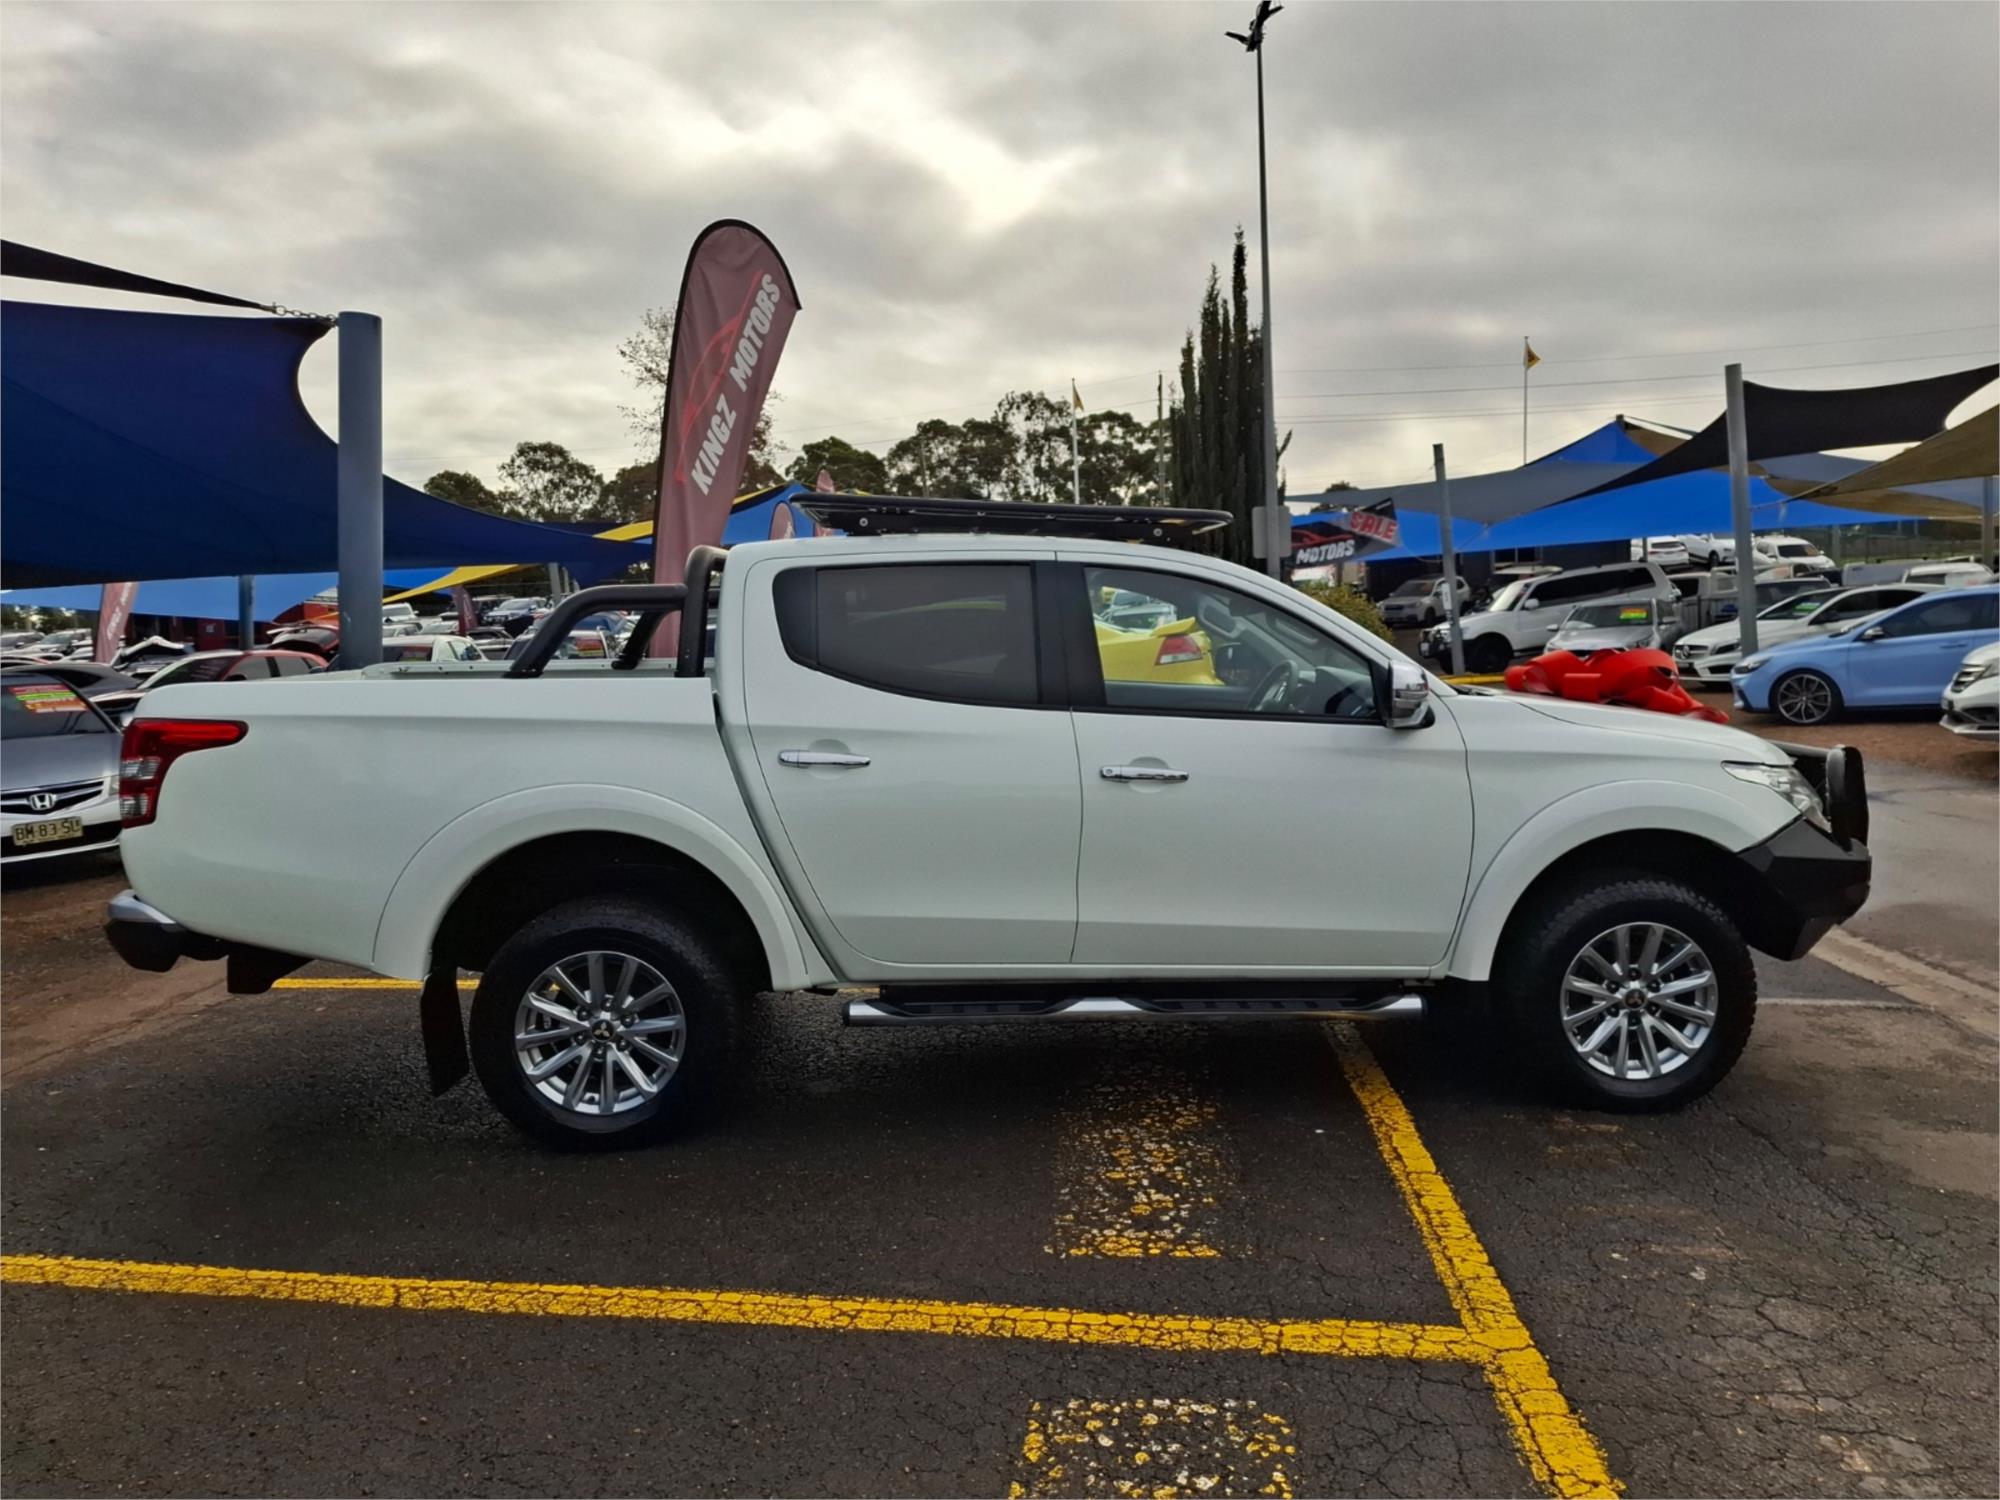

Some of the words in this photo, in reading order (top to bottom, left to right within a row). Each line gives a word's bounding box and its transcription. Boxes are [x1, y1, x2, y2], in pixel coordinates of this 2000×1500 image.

[691, 393, 737, 496] KINGZ
[729, 273, 781, 392] MOTORS
[1350, 511, 1397, 540] SALE
[1296, 539, 1355, 564] MOTORS
